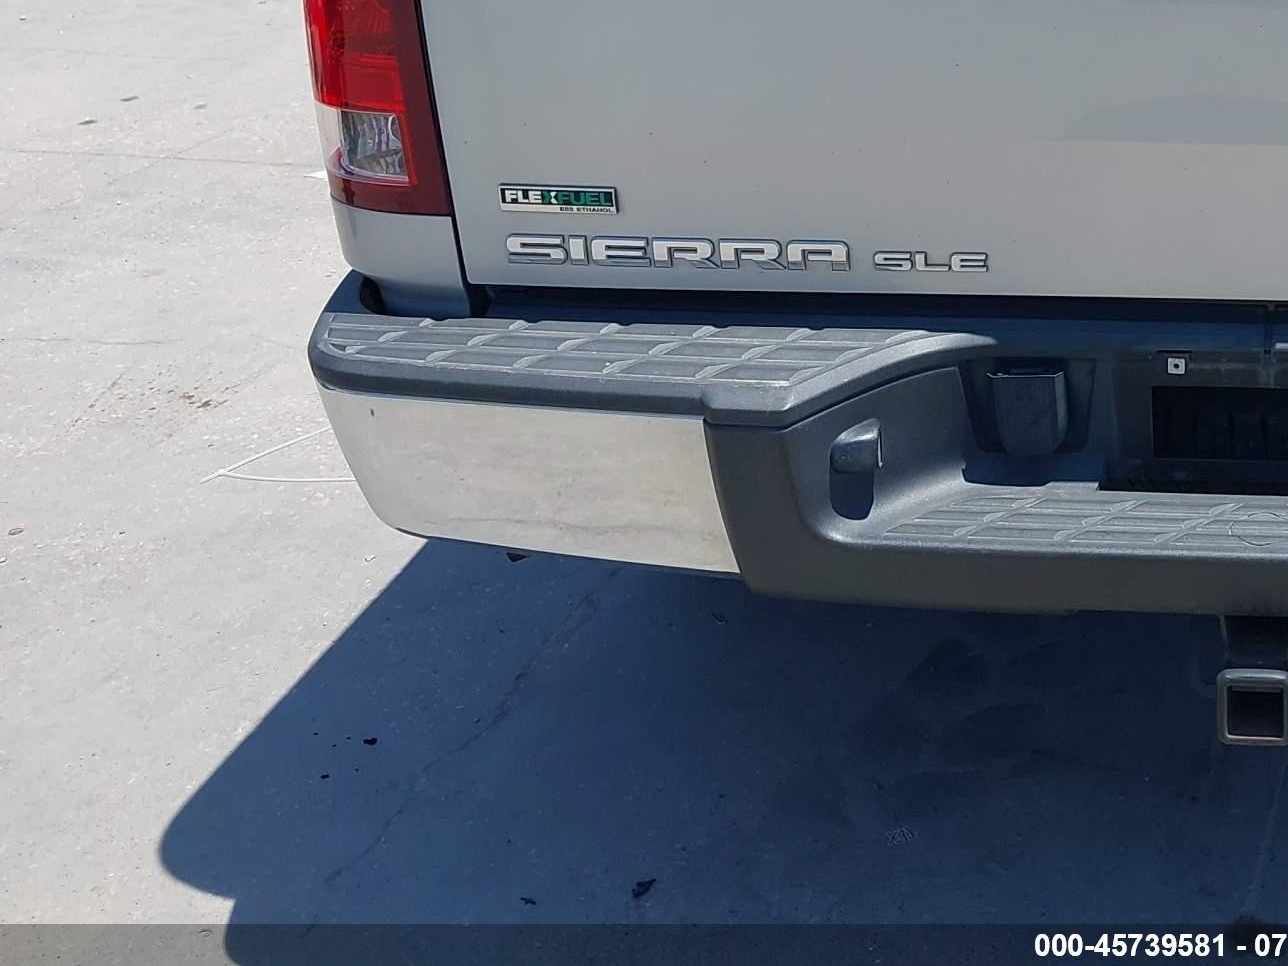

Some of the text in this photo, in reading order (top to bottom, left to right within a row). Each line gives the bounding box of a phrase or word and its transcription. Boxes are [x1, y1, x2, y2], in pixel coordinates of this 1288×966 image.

[504, 189, 612, 205] FLEXFUEL
[506, 233, 989, 272] SIERRA SLE
